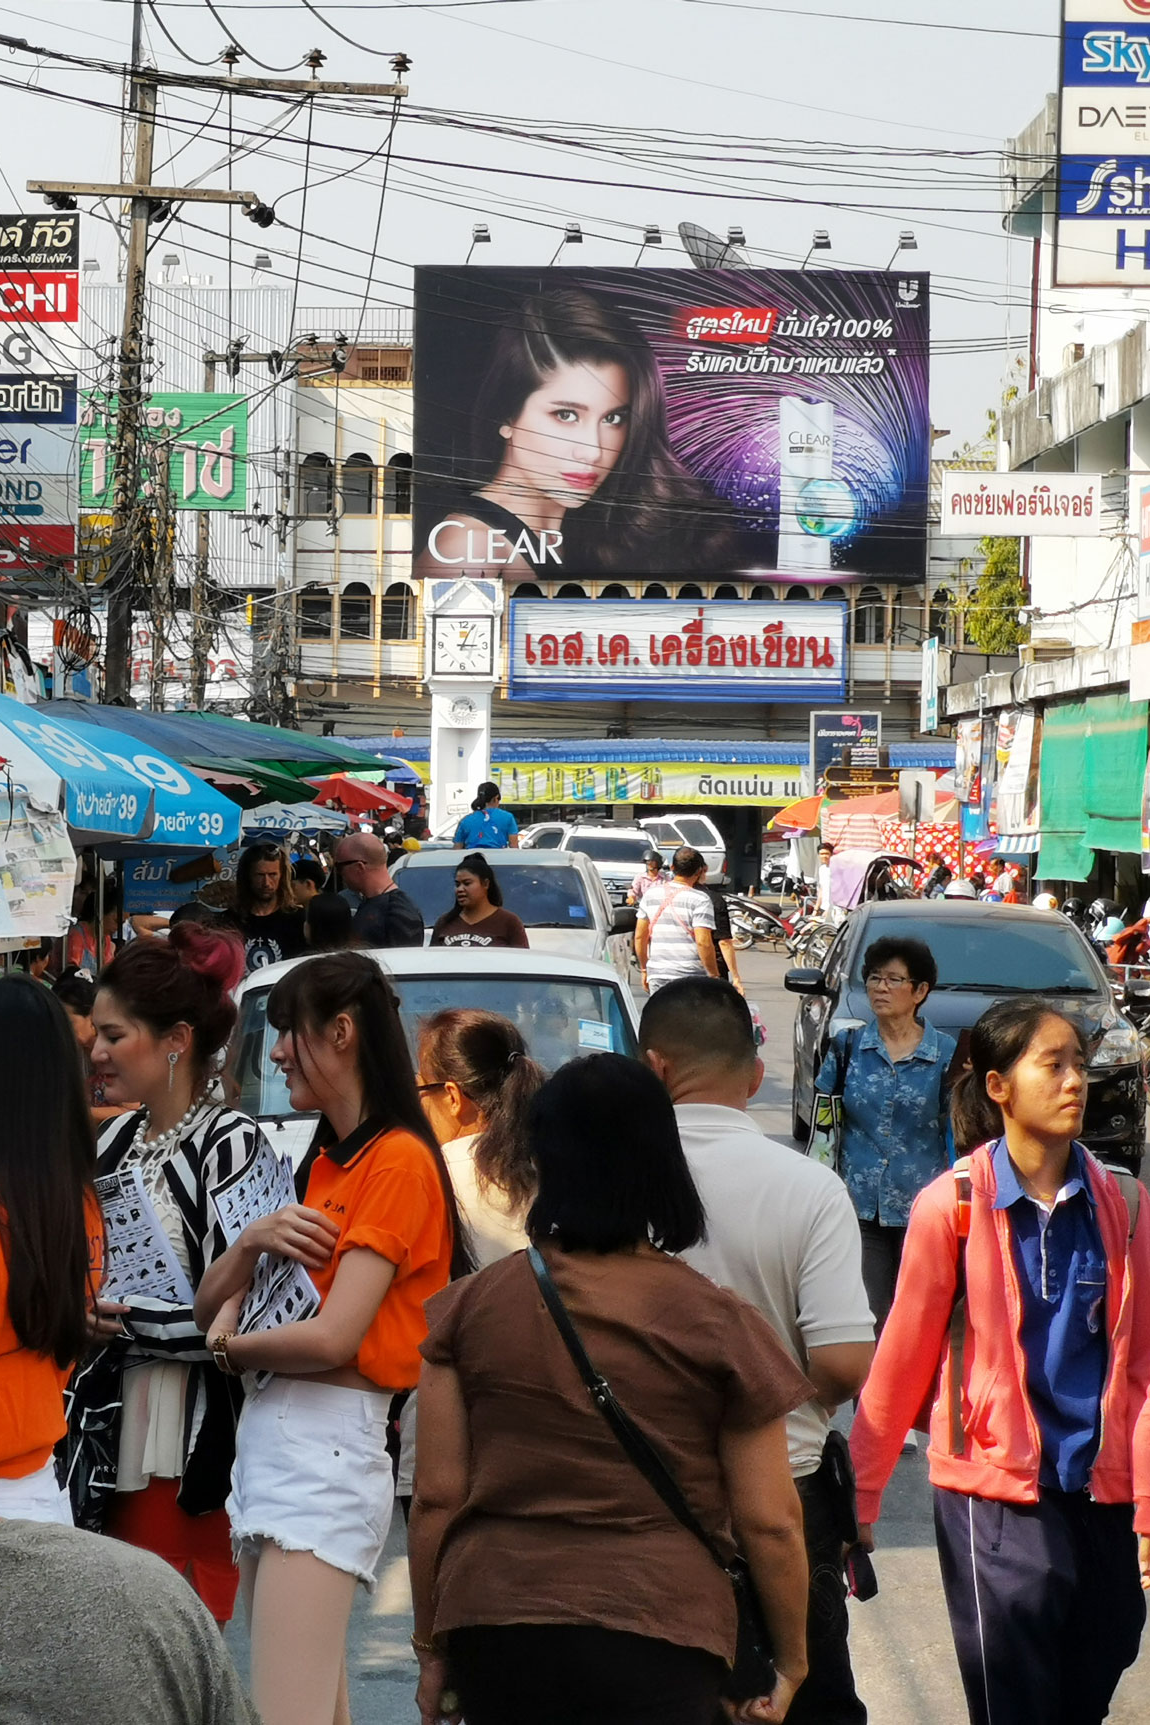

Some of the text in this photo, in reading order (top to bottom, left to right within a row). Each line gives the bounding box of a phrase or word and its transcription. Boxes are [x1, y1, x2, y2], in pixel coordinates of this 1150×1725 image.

[1078, 106, 1150, 128] DAE
[30, 219, 75, 248] ทีวี
[686, 311, 771, 340] สูตรใหม่
[788, 431, 831, 447] CLEAR
[951, 484, 1094, 518] คงชัยเฟอร์นิเจอร์
[428, 520, 564, 565] CLEAR
[458, 620, 470, 629] 12
[438, 641, 445, 650] 9
[481, 641, 488, 650] 3
[459, 662, 466, 671] 6
[699, 775, 773, 796] ติดแน่น
[118, 793, 137, 821] 39
[198, 812, 224, 836] 39
